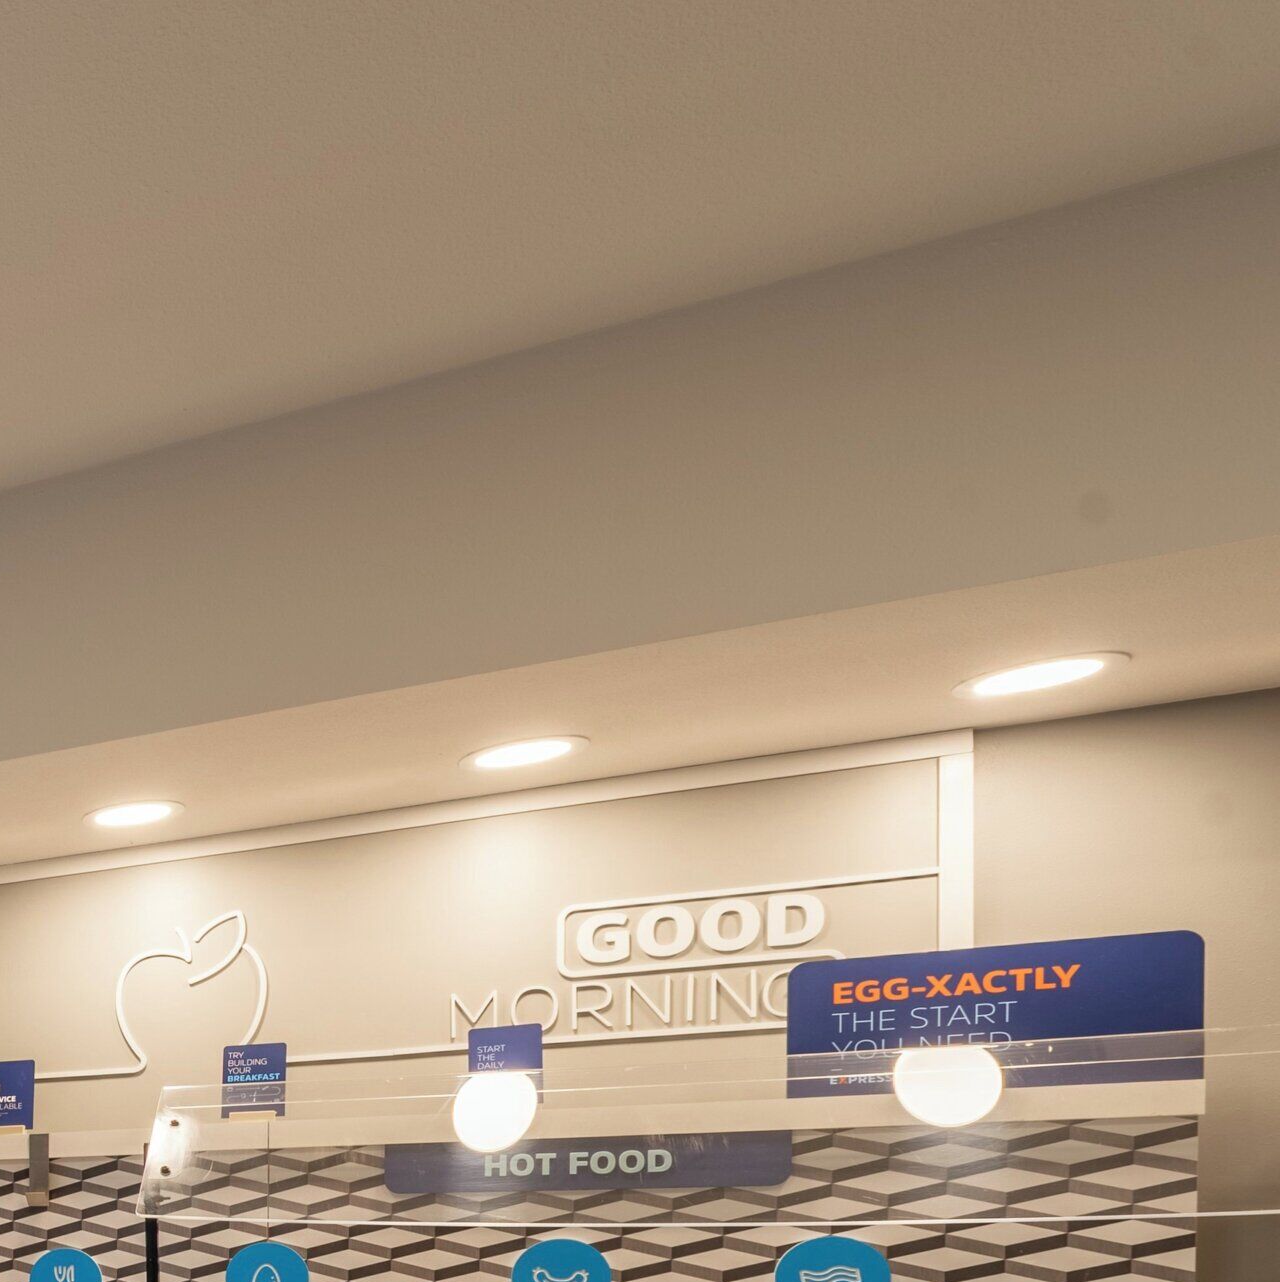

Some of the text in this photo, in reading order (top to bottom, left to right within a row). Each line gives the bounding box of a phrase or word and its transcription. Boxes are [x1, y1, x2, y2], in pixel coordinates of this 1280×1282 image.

[576, 893, 825, 965] GOOD
[832, 963, 1082, 1005] EGG-XACTLY
[831, 1000, 1018, 1033] THE START
[476, 1044, 507, 1054] START
[831, 1038, 904, 1061] YOU
[228, 1051, 245, 1059] TRY
[477, 1053, 496, 1061] THE
[227, 1057, 268, 1067] BUILDING
[476, 1061, 505, 1070] DAILY
[227, 1066, 252, 1075] YOUR
[227, 1072, 281, 1083] BREAKFAST
[484, 1148, 673, 1177] HOT FOOD
